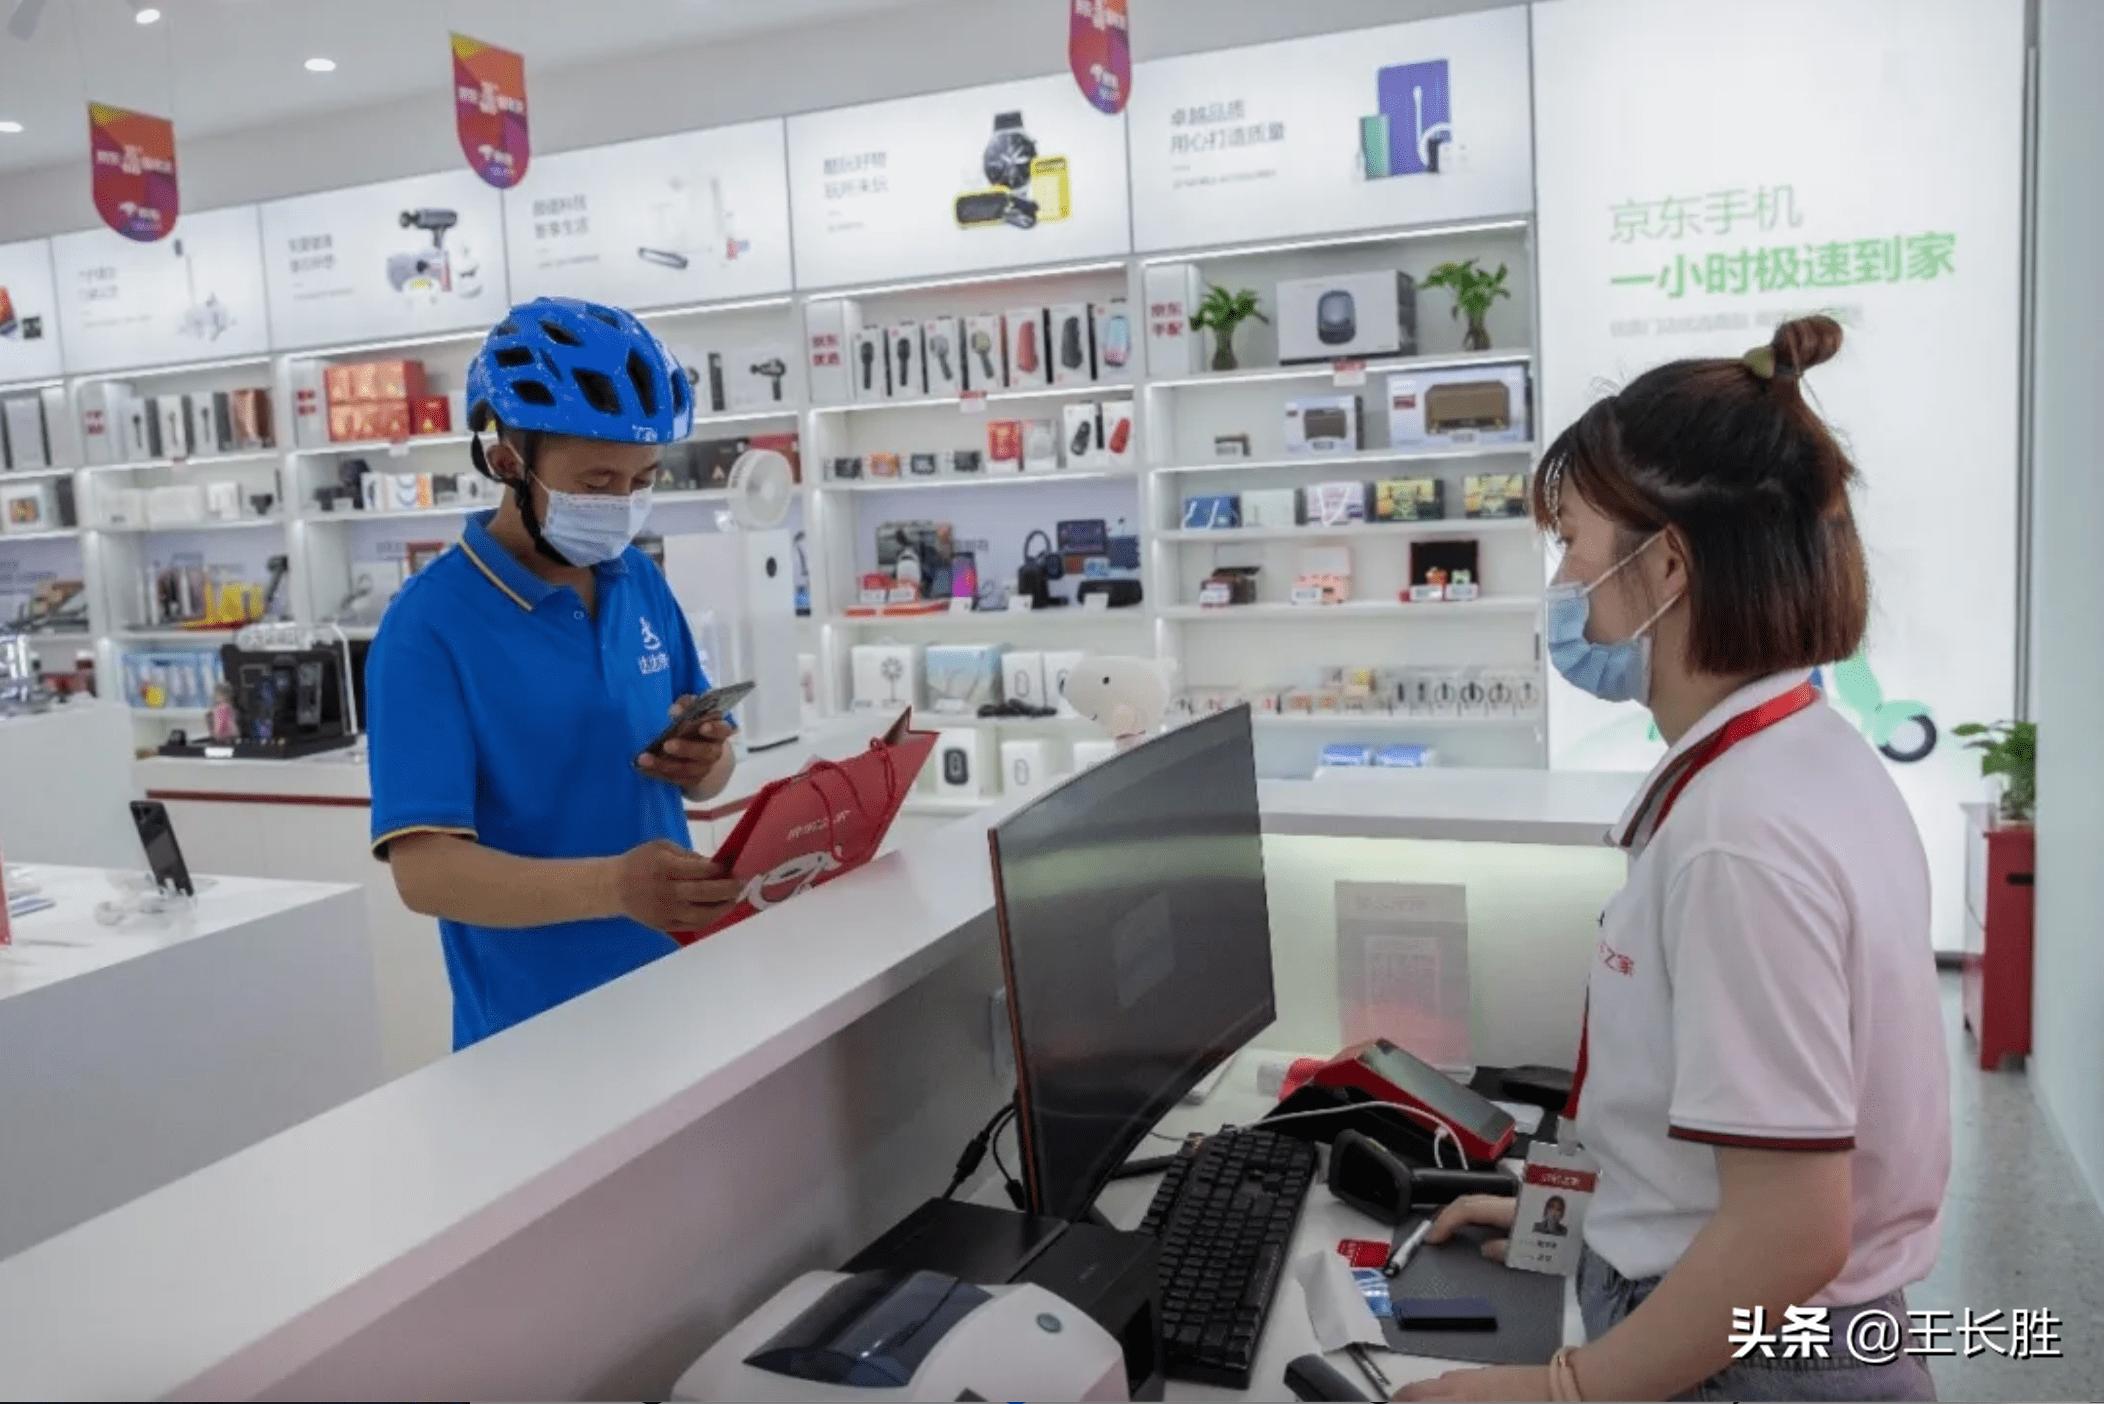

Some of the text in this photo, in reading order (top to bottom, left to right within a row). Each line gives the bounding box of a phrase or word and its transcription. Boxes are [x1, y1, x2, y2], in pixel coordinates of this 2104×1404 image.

[1170, 99, 1245, 127] 卓越品质
[1170, 121, 1285, 154] 用心打造质量
[1609, 184, 1803, 243] 京东手机
[1610, 231, 1956, 299] 一小时极速到家
